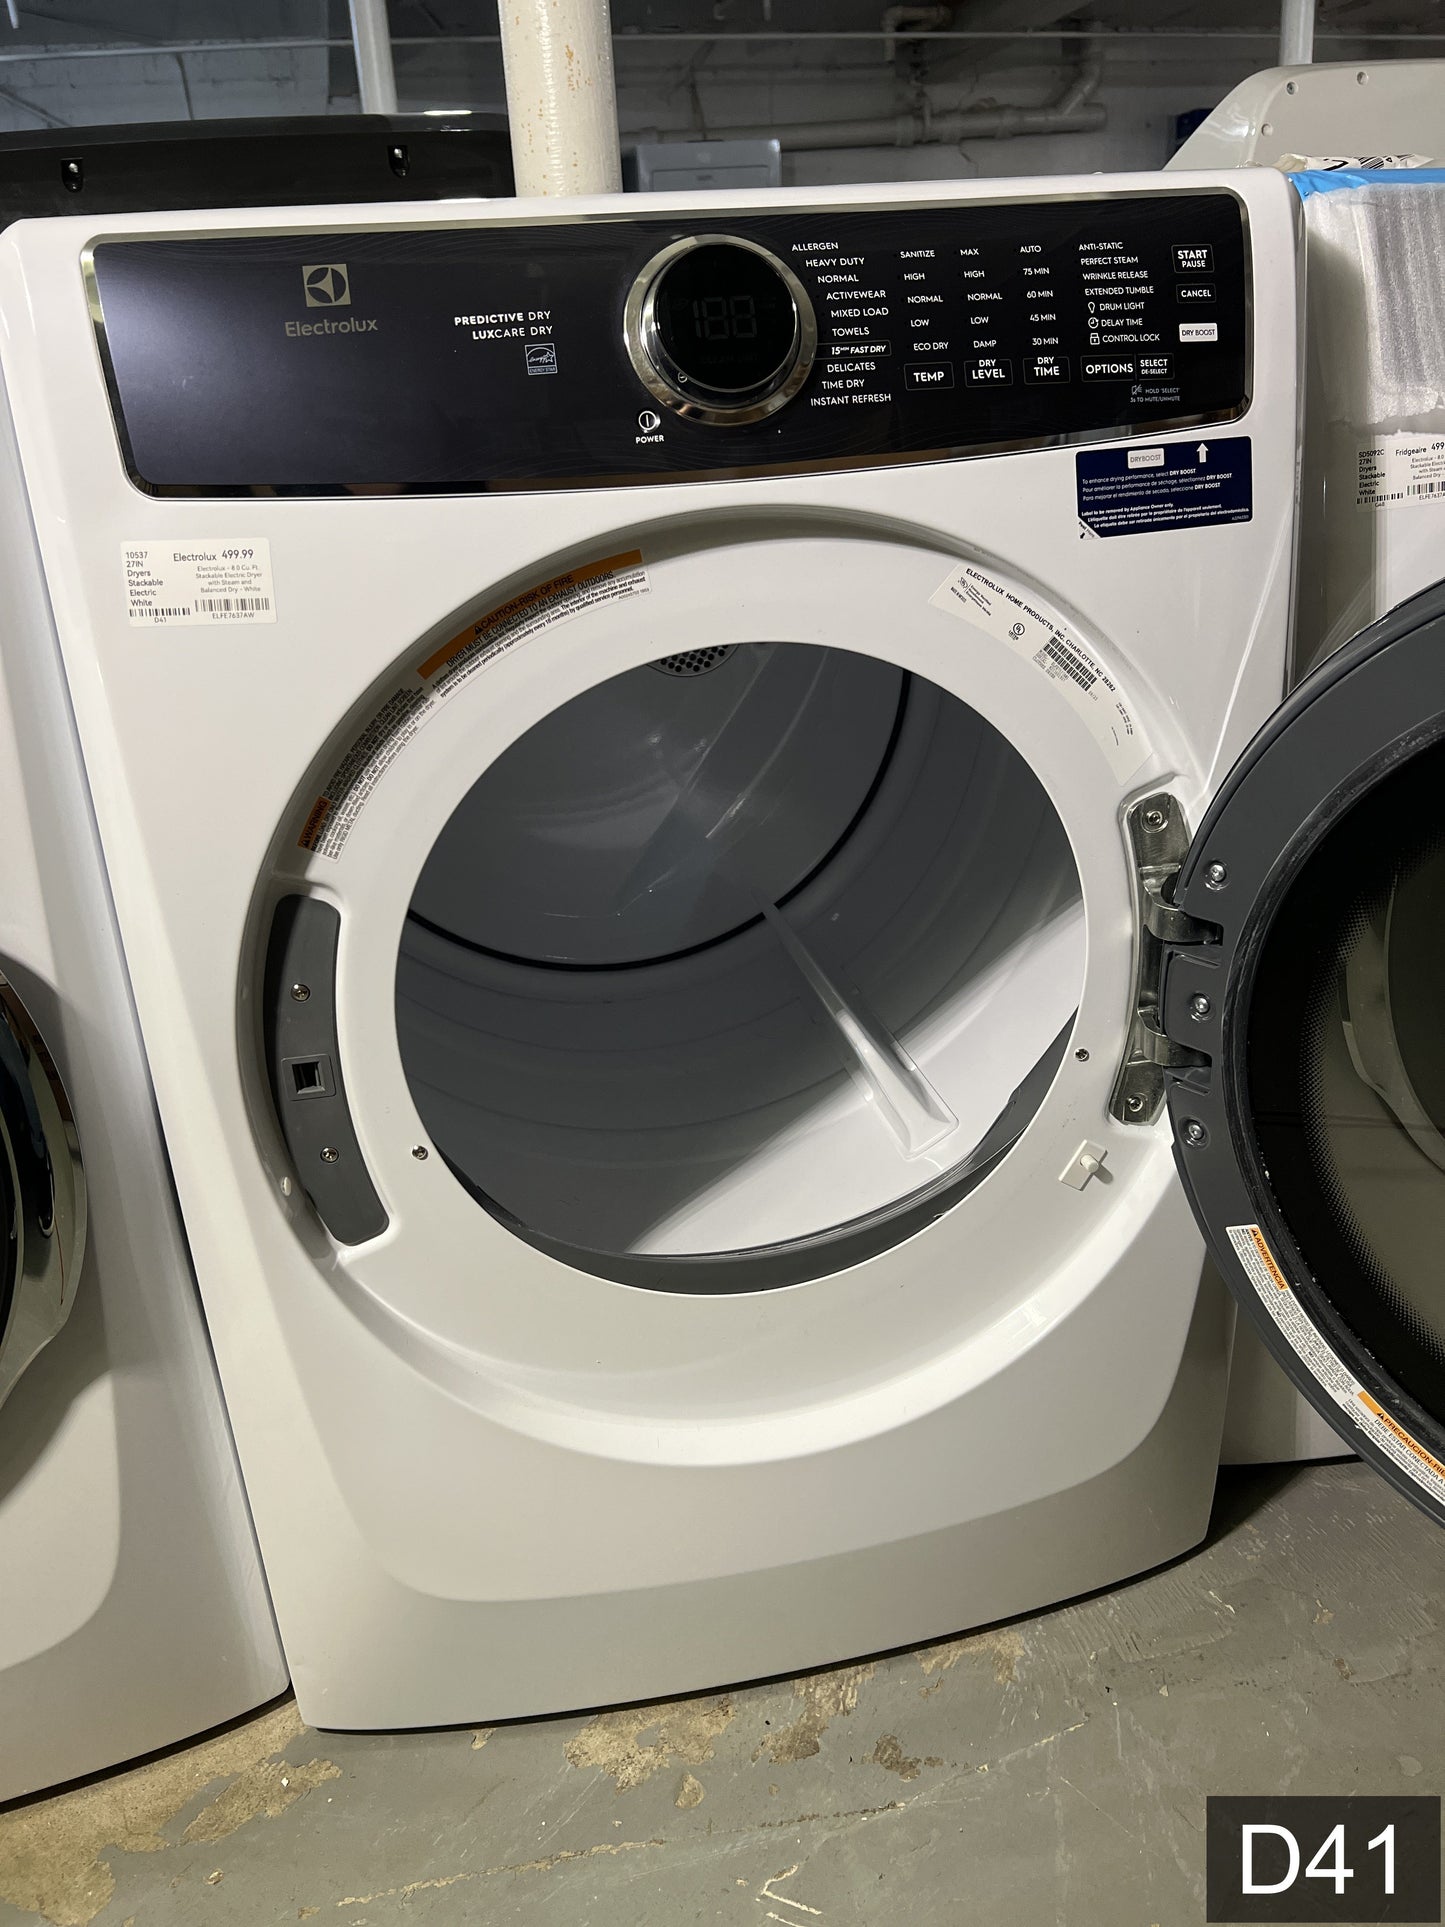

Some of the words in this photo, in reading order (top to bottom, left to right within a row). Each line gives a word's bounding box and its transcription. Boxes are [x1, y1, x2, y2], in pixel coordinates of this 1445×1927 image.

[792, 242, 839, 251] ALLERGEN
[1020, 245, 1042, 253] AUTO
[1079, 242, 1123, 251] ANTI-STATIC
[900, 250, 935, 259] SANITIZE
[1178, 249, 1207, 259] START
[806, 258, 837, 267] HEAVY
[840, 257, 865, 266] DUTY
[1114, 256, 1138, 264] STEAM
[1034, 267, 1050, 275] MIN
[1083, 272, 1116, 280] WRINKLE
[1118, 271, 1148, 279] RELEASE
[818, 274, 859, 283] NORMAL
[826, 290, 886, 300] ACTIVEWEAR
[1038, 290, 1053, 298] MIN
[1085, 287, 1124, 296] EXTENDED
[1125, 286, 1154, 294] TUMBLE
[1181, 289, 1211, 298] CANCEL
[907, 295, 943, 303] NORMAL
[968, 293, 1003, 301] NORMAL
[1099, 303, 1122, 311] DRUM
[1124, 302, 1144, 310] LIGHT
[831, 308, 860, 318] MIXED
[863, 307, 889, 316] LOAD
[1041, 313, 1056, 321] MIN
[454, 312, 524, 326] PREDICTIVE
[528, 310, 552, 321] DRY
[970, 316, 989, 324] LOW
[1101, 319, 1125, 327] DELAY
[1126, 318, 1143, 326] TIME
[284, 317, 378, 337] Electrolux
[911, 319, 930, 327] LOW
[472, 327, 526, 340] LUXCARE
[530, 325, 553, 337] DRY
[832, 327, 870, 336] TOWELS
[1043, 337, 1059, 345] MIN
[1102, 334, 1139, 342] CONTROL
[913, 343, 931, 351] ECO
[933, 342, 949, 350] DRY
[973, 340, 997, 348] DAMP
[850, 346, 870, 354] FAST
[870, 345, 886, 353] DRY
[827, 362, 876, 373] DELICATES
[979, 359, 996, 367] DRY
[1140, 359, 1168, 367] SELECT
[1034, 366, 1060, 377] TIME
[1086, 363, 1134, 374] OPTIONS
[914, 372, 945, 382] TEMP
[972, 369, 1005, 379] LEVEL
[822, 380, 845, 390] TIME
[846, 379, 865, 389] DRY
[811, 396, 849, 406] INSTANT
[852, 394, 891, 404] REFRESH
[635, 435, 665, 444] POWER
[1142, 454, 1161, 462] BOOST
[1359, 465, 1376, 473] Dryers
[173, 552, 217, 562] Electrolux
[222, 549, 254, 559] 499.99
[127, 570, 151, 578] Dryers
[128, 579, 163, 587] Stackable
[540, 584, 552, 594] OF
[554, 574, 574, 589] FIRE
[130, 589, 157, 597] Electric
[131, 599, 152, 607] White
[966, 568, 1005, 596] ELECTROLUX
[1006, 592, 1024, 608] HOME
[1022, 605, 1054, 632] PRODUCTS,
[1065, 639, 1096, 670] CHARLOTTE,
[1094, 668, 1104, 677] NC
[465, 637, 483, 654] MUST
[303, 801, 328, 843] WARNING
[1256, 1236, 1285, 1290] ADVERTENCIA
